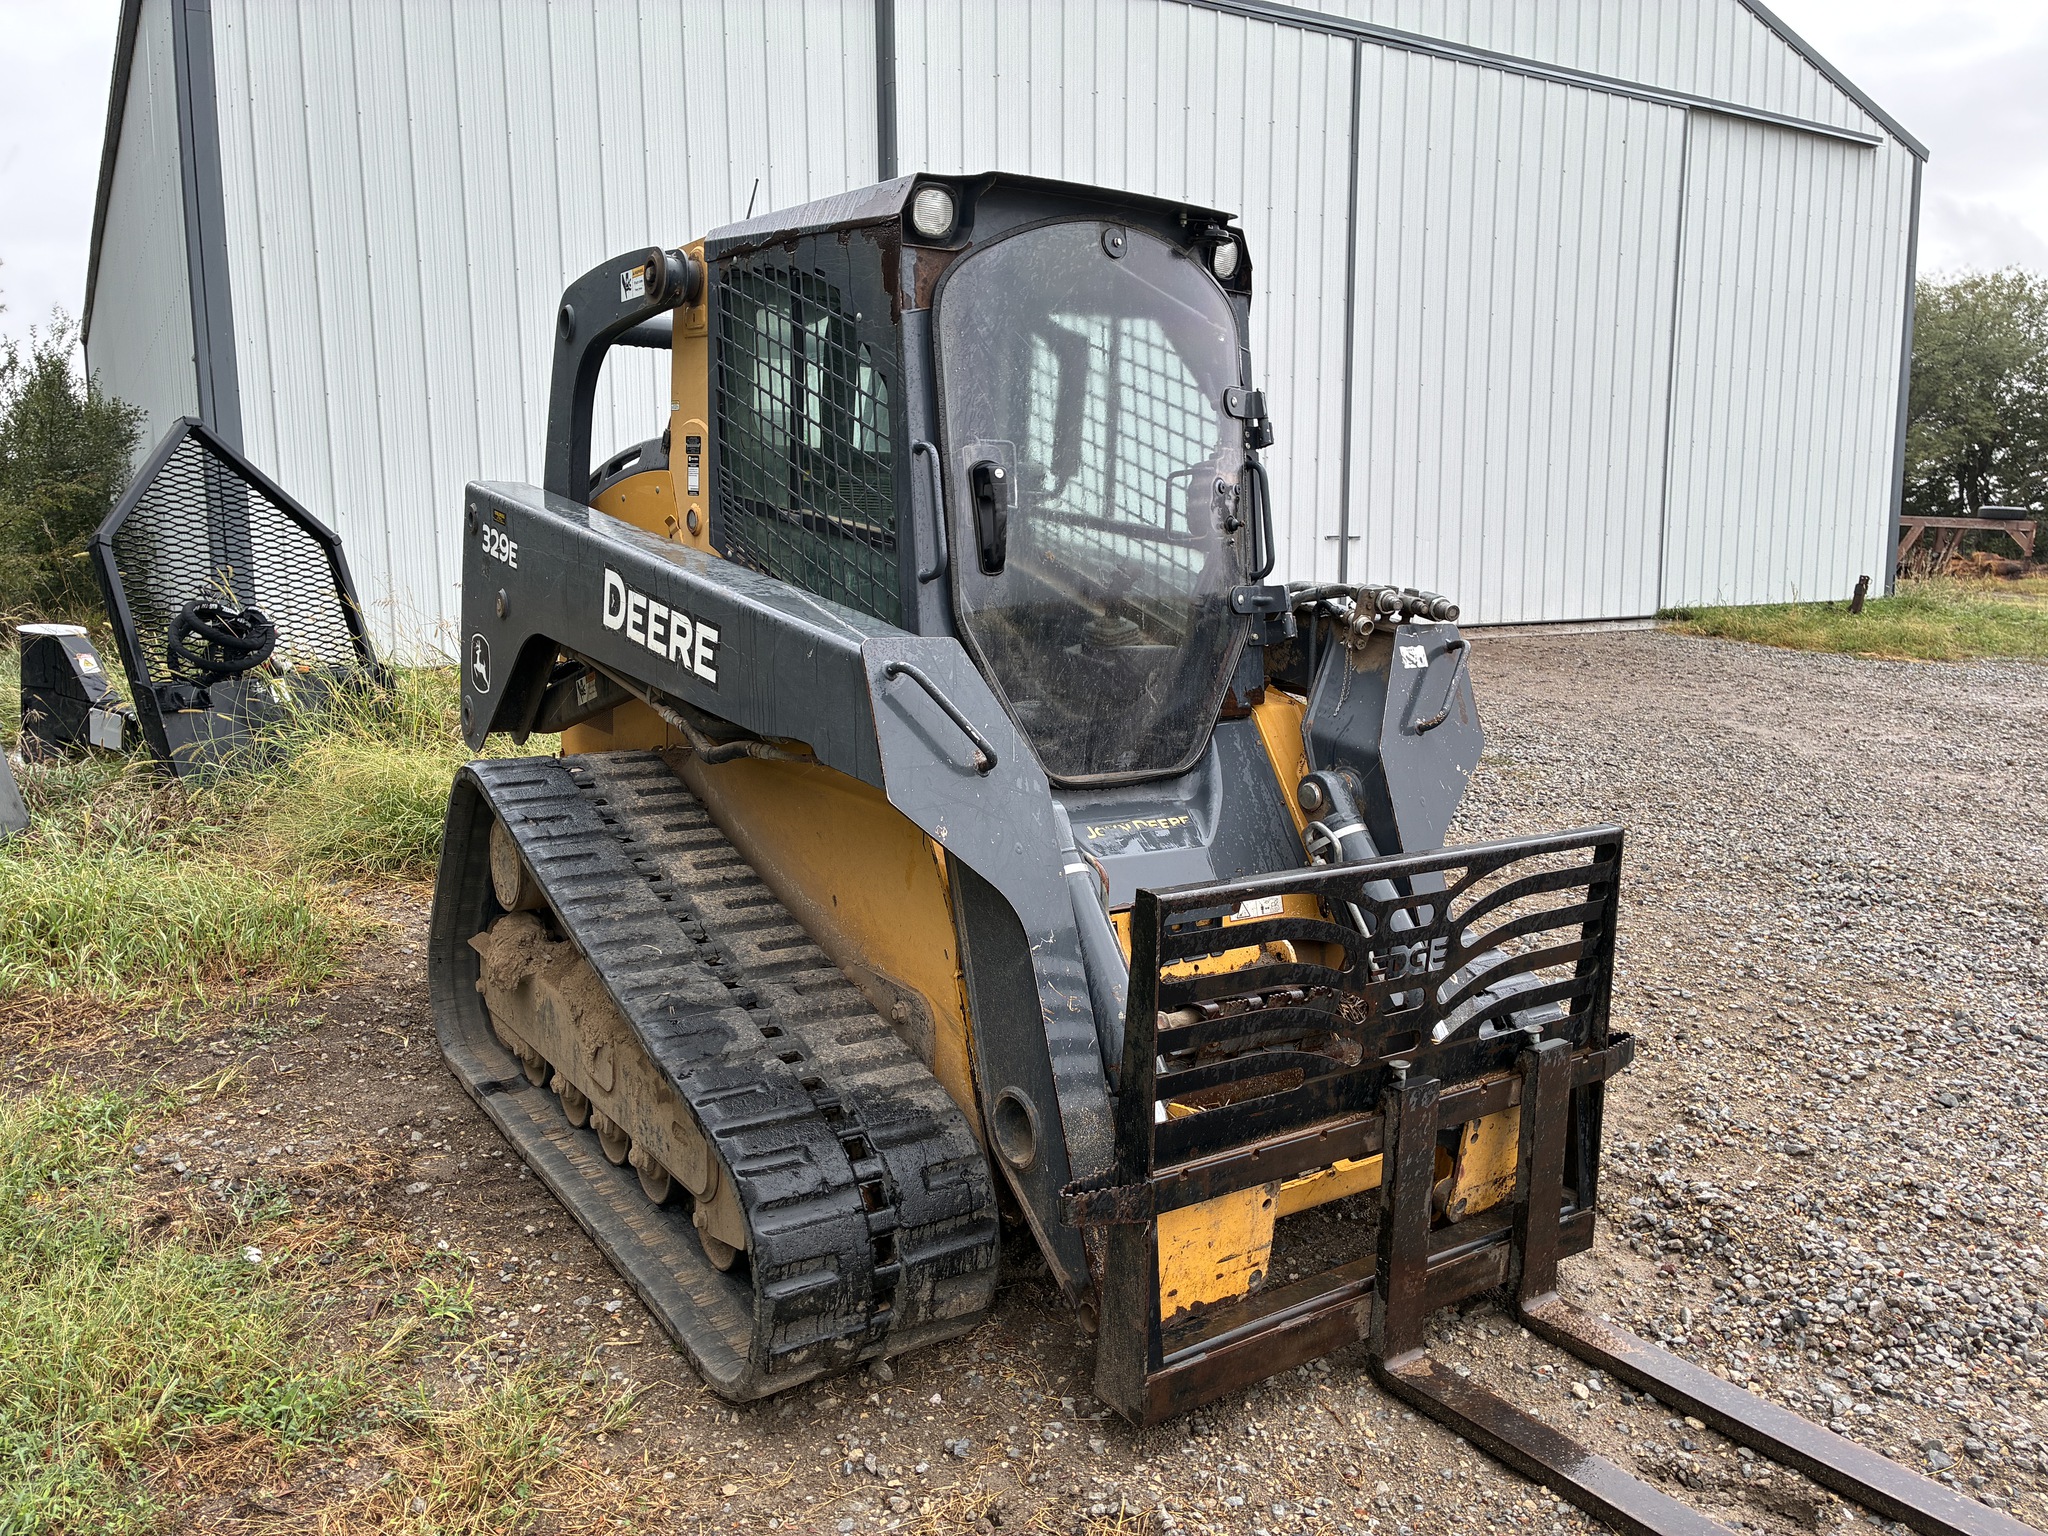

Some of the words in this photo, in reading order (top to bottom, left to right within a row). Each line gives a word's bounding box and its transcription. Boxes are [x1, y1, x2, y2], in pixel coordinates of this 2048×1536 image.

[481, 522, 519, 570] 329E
[602, 567, 720, 684] DEERE
[1366, 936, 1449, 985] EDGE
